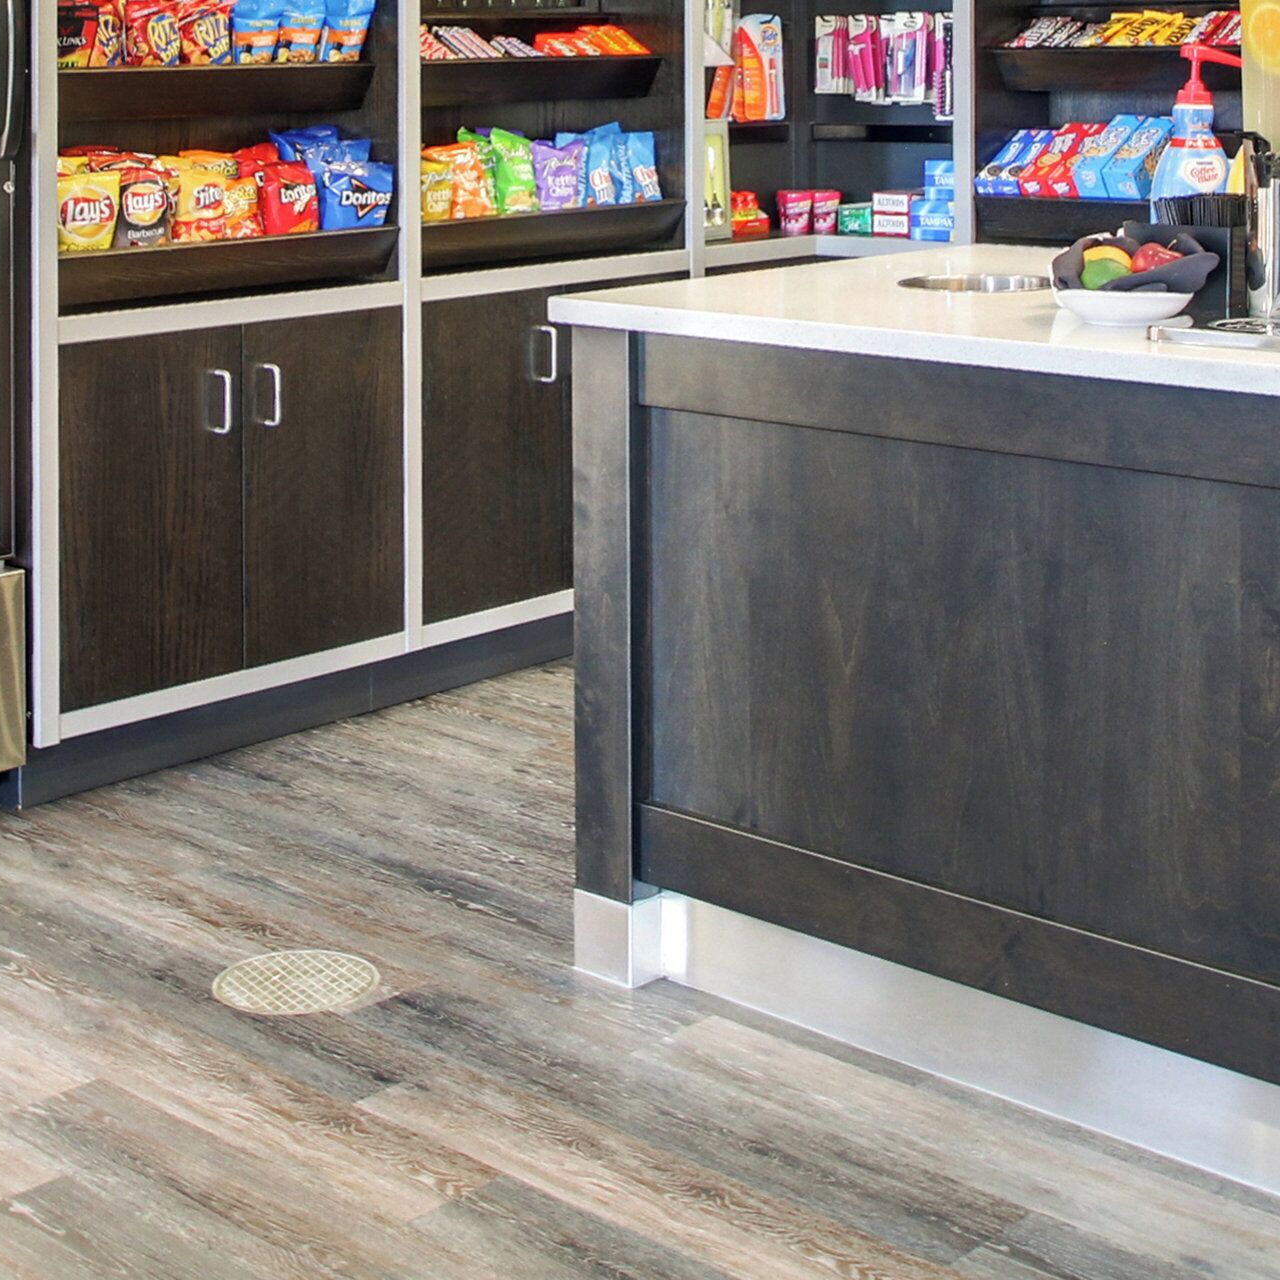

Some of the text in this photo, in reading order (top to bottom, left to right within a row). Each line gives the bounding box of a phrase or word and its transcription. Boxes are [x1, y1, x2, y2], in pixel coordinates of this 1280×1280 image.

[148, 19, 179, 50] RITZ
[194, 16, 230, 46] RITZ
[127, 191, 163, 215] Lay's
[341, 190, 393, 208] Doritos
[877, 200, 905, 208] ALTOIDS
[66, 198, 111, 227] Lay's
[920, 216, 953, 227] TAMPAX
[127, 226, 165, 239] Barbecue
[877, 220, 906, 229] ALTOIDS
